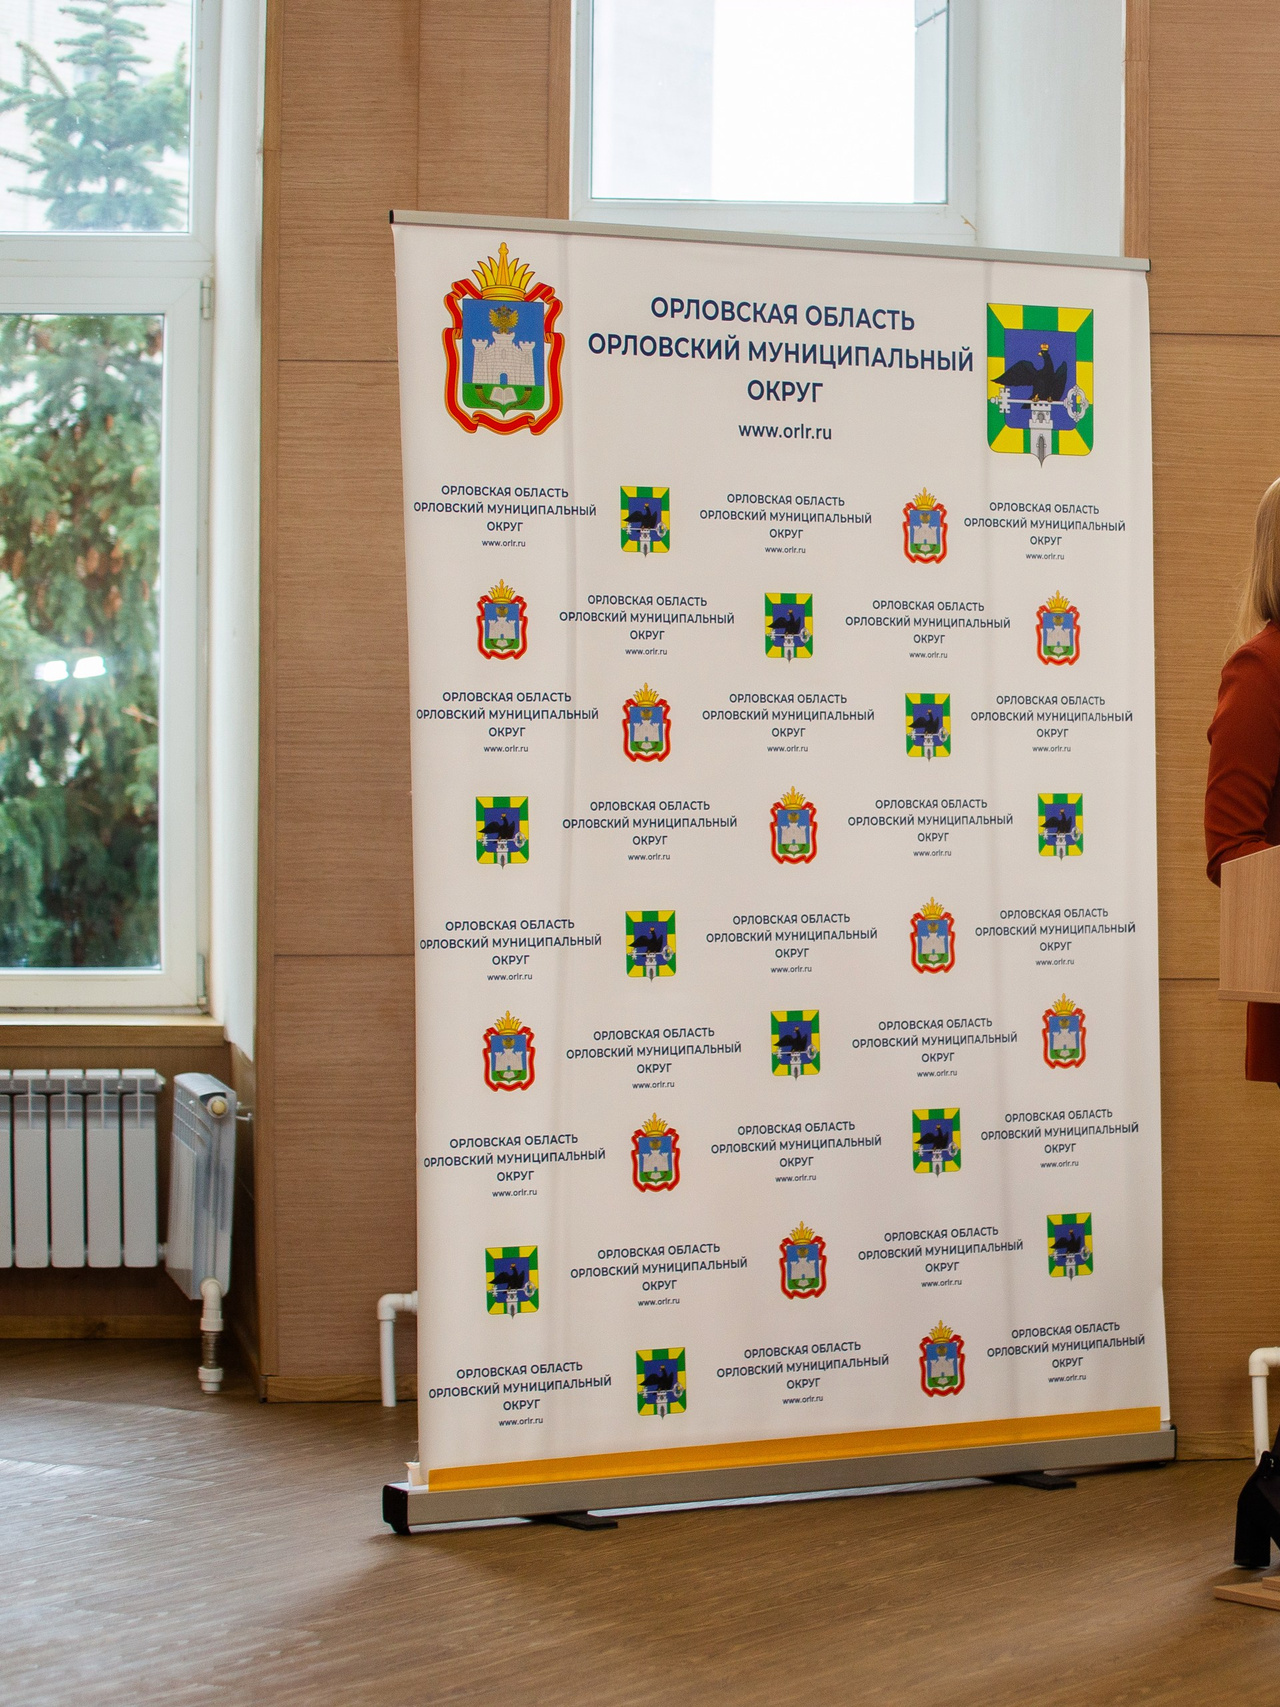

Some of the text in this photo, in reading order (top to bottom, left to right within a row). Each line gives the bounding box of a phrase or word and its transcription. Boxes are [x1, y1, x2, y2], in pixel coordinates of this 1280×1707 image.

[650, 296, 916, 331] ОРЛОВСКАЯ ОБЛАСТЬ
[587, 332, 974, 373] ОРЛОВСКИЙ МУНИЦИПАЛЬНЫЙ
[747, 379, 824, 403] ОКРУГ
[737, 422, 832, 441] www.orlr.ru
[440, 484, 570, 499] ОРЛОВСКАЯ ОБЛАСТЬ
[726, 493, 846, 507] ОРЛОВСКАЯ ОБЛАСТЬ
[413, 500, 597, 517] ОРЛОВСКИЙ МУНИЦИПАЛЬНЫЙ
[988, 501, 1100, 515] ОРЛОВСКАЯ ОБЛАСТЬ
[699, 508, 872, 525] ОРЛОВСКИЙ МУНИЦИПАЛЬНЫЙ
[486, 520, 524, 532] ОКРУГ
[963, 516, 1126, 532] ОРЛОВСКИЙ МУНИЦИПАЛЬНЫЙ
[768, 528, 804, 539] ОКРУГ
[481, 539, 526, 548] www.orlr.ru
[1029, 535, 1063, 546] ОКРУГ
[764, 545, 807, 554] www.orlr.ru
[1025, 552, 1065, 561] www.orlr.ru
[587, 594, 708, 607] ОРЛОВСКАЯ ОБЛАСТЬ
[872, 599, 985, 612] ОРЛОВСКАЯ ОБЛАСТЬ
[558, 609, 735, 625] ОРЛОВСКИЙ МУНИЦИПАЛЬНЫЙ
[844, 614, 1011, 630] ОРЛОВСКИЙ МУНИЦИПАЛЬНЫЙ
[629, 629, 666, 641] ОКРУГ
[912, 633, 946, 644] ОКРУГ
[624, 647, 668, 656] www.orlr.ru
[908, 651, 948, 659] www.orlr.ru
[442, 691, 572, 703] ОРЛОВСКАЯ ОБЛАСТЬ
[728, 693, 848, 704] ОРЛОВСКАЯ ОБЛАСТЬ
[995, 695, 1106, 706] ОРЛОВСКАЯ ОБЛАСТЬ
[416, 706, 599, 722] ОРЛОВСКИЙ МУНИЦИПАЛЬНЫЙ
[701, 707, 875, 723] ОРЛОВСКИЙ МУНИЦИПАЛЬНЫЙ
[970, 709, 1133, 724] ОРЛОВСКИЙ МУНИЦИПАЛЬНЫЙ
[488, 726, 527, 738] ОКРУГ
[771, 727, 807, 738] ОКРУГ
[1036, 728, 1070, 738] ОКРУГ
[483, 744, 529, 753] www.orlr.ru
[766, 744, 809, 753] www.orlr.ru
[1031, 744, 1072, 753] www.orlr.ru
[589, 800, 711, 812] ОРЛОВСКАЯ ОБЛАСТЬ
[874, 798, 988, 810] ОРЛОВСКАЯ ОБЛАСТЬ
[562, 814, 738, 830] ОРЛОВСКИЙ МУНИЦИПАЛЬНЫЙ
[847, 812, 1014, 827] ОРЛОВСКИЙ МУНИЦИПАЛЬНЫЙ
[632, 835, 669, 846] ОКРУГ
[917, 832, 950, 843] ОКРУГ
[627, 852, 671, 861] www.orlr.ru
[912, 848, 952, 857] www.orlr.ru
[732, 913, 851, 926] ОРЛОВСКАЯ ОБЛАСТЬ
[999, 907, 1109, 920] ОРЛОВСКАЯ ОБЛАСТЬ
[444, 918, 576, 932] ОРЛОВСКАЯ ОБЛАСТЬ
[974, 921, 1136, 937] ОРЛОВСКИЙ МУНИЦИПАЛЬНЫЙ
[419, 933, 602, 950] ОРЛОВСКИЙ МУНИЦИПАЛЬНЫЙ
[705, 926, 878, 944] ОРЛОВСКИЙ МУНИЦИПАЛЬНЫЙ
[774, 947, 810, 959] ОКРУГ
[1039, 941, 1073, 952] ОКРУГ
[491, 954, 531, 966] ОКРУГ
[1035, 958, 1075, 966] www.orlr.ru
[770, 965, 813, 974] www.orlr.ru
[486, 972, 533, 981] www.orlr.ru
[877, 1017, 993, 1031] ОРЛОВСКАЯ ОБЛАСТЬ
[592, 1026, 716, 1042] ОРЛОВСКАЯ ОБЛАСТЬ
[851, 1030, 1018, 1049] ОРЛОВСКИЙ МУНИЦИПАЛЬНЫЙ
[565, 1040, 742, 1060] ОРЛОВСКИЙ МУНИЦИПАЛЬНЫЙ
[921, 1051, 956, 1063] ОКРУГ
[636, 1062, 673, 1074] ОКРУГ
[916, 1069, 958, 1078] www.orlr.ru
[631, 1080, 675, 1090] www.orlr.ru
[1004, 1108, 1114, 1124] ОРЛОВСКАЯ ОБЛАСТЬ
[737, 1120, 856, 1136] ОРЛОВСКАЯ ОБЛАСТЬ
[980, 1121, 1139, 1141] ОРЛОВСКИЙ МУНИЦИПАЛЬНЫЙ
[449, 1133, 579, 1149] ОРЛОВСКАЯ ОБЛАСТЬ
[710, 1133, 882, 1155] ОРЛОВСКИЙ МУНИЦИПАЛЬНЫЙ
[1043, 1142, 1077, 1154] ОКРУГ
[423, 1147, 606, 1168] ОРЛОВСКИЙ МУНИЦИПАЛЬНЫЙ
[779, 1156, 815, 1168] ОКРУГ
[1039, 1159, 1080, 1169] www.orlr.ru
[496, 1170, 535, 1182] ОКРУГ
[774, 1173, 817, 1183] www.orlr.ru
[491, 1188, 538, 1198] www.orlr.ru
[883, 1225, 999, 1243] ОРЛОВСКАЯ ОБЛАСТЬ
[597, 1242, 721, 1260] ОРЛОВСКАЯ ОБЛАСТЬ
[857, 1238, 1024, 1261] ОРЛОВСКИЙ МУНИЦИПАЛЬНЫЙ
[570, 1255, 748, 1279] ОРЛОВСКИЙ МУНИЦИПАЛЬНЫЙ
[924, 1261, 960, 1273] ОКРУГ
[641, 1279, 678, 1292] ОКРУГ
[920, 1278, 963, 1288] www.orlr.ru
[637, 1297, 681, 1307] www.orlr.ru
[1011, 1321, 1121, 1340] ОРЛОВСКАЯ ОБЛАСТЬ
[743, 1340, 862, 1360] ОРЛОВСКАЯ ОБЛАСТЬ
[986, 1333, 1146, 1358] ОРЛОВСКИЙ МУНИЦИПАЛЬНЫЙ
[716, 1353, 890, 1379] ОРЛОВСКИЙ МУНИЦИПАЛЬНЫЙ
[1051, 1356, 1084, 1369] ОКРУГ
[456, 1361, 584, 1380] ОРЛОВСКАЯ ОБЛАСТЬ
[786, 1377, 821, 1390] ОКРУГ
[1047, 1373, 1087, 1383] www.orlr.ru
[428, 1373, 612, 1399] ОРЛОВСКИЙ МУНИЦИПАЛЬНЫЙ
[502, 1398, 541, 1411] ОКРУГ
[781, 1395, 824, 1405] www.orlr.ru
[498, 1416, 544, 1427] www.orlr.ru
